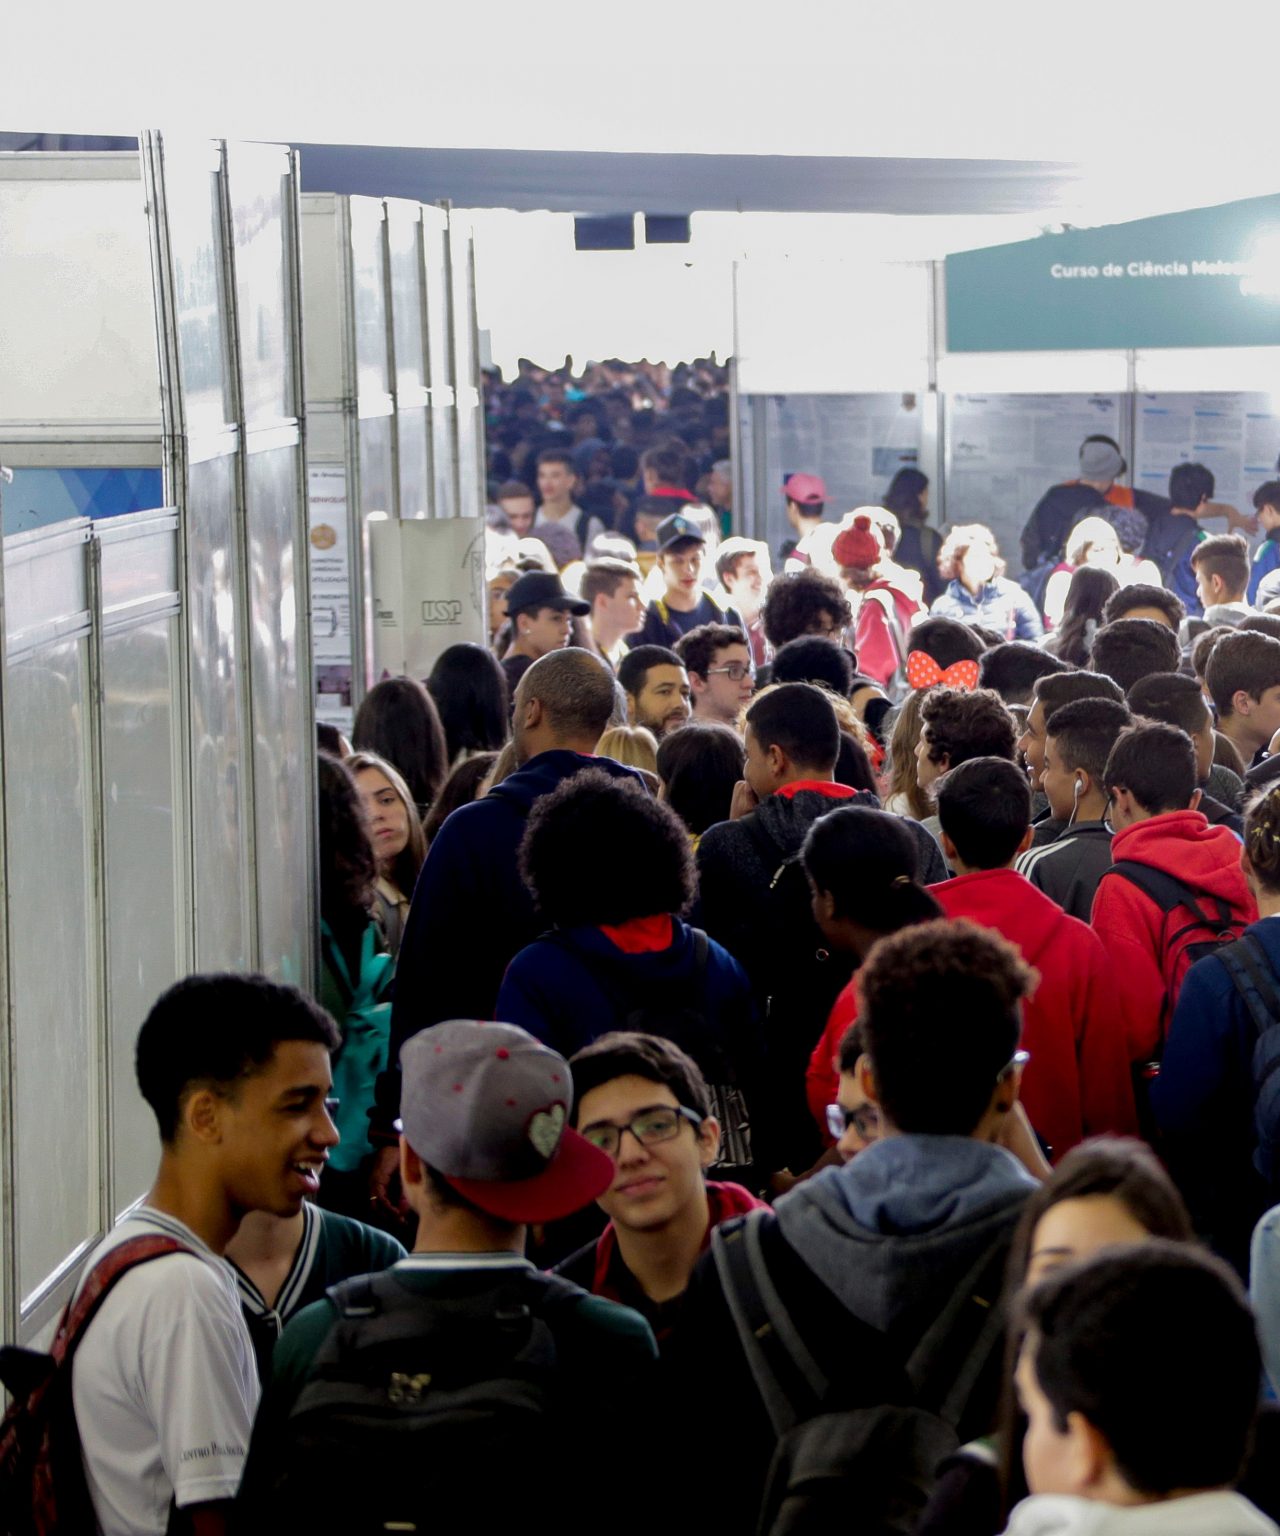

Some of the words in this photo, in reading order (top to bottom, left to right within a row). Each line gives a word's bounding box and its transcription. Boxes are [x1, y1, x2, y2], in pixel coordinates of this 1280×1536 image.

[1050, 263, 1098, 278] Curso
[1102, 263, 1123, 277] de
[1127, 260, 1188, 277] Ciência
[422, 600, 462, 622] USP
